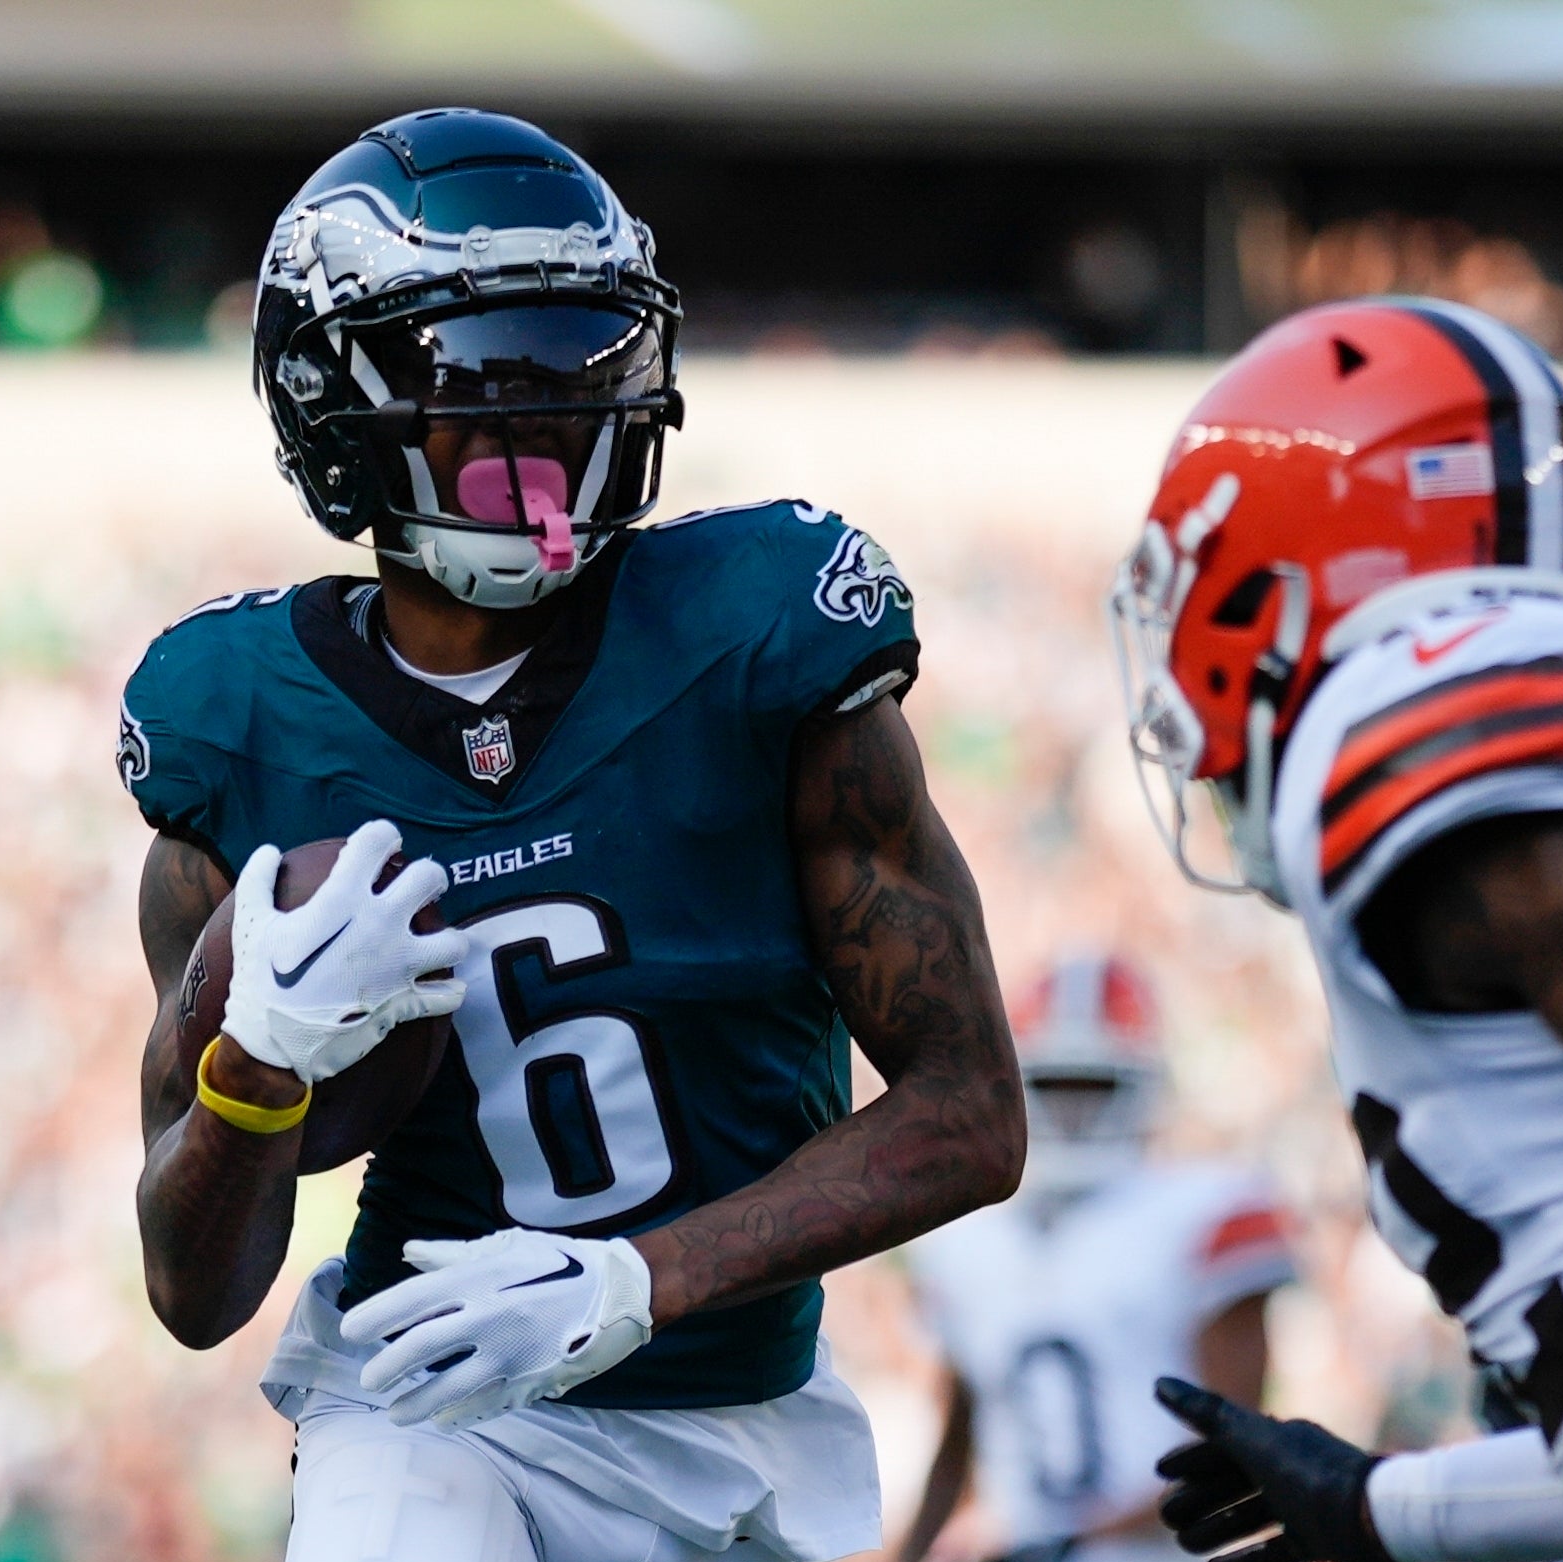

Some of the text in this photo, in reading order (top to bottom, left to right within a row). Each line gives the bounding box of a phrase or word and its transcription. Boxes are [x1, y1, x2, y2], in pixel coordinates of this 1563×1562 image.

[474, 747, 508, 773] NFL
[449, 832, 574, 886] EAGLES
[450, 894, 684, 1233] 6
